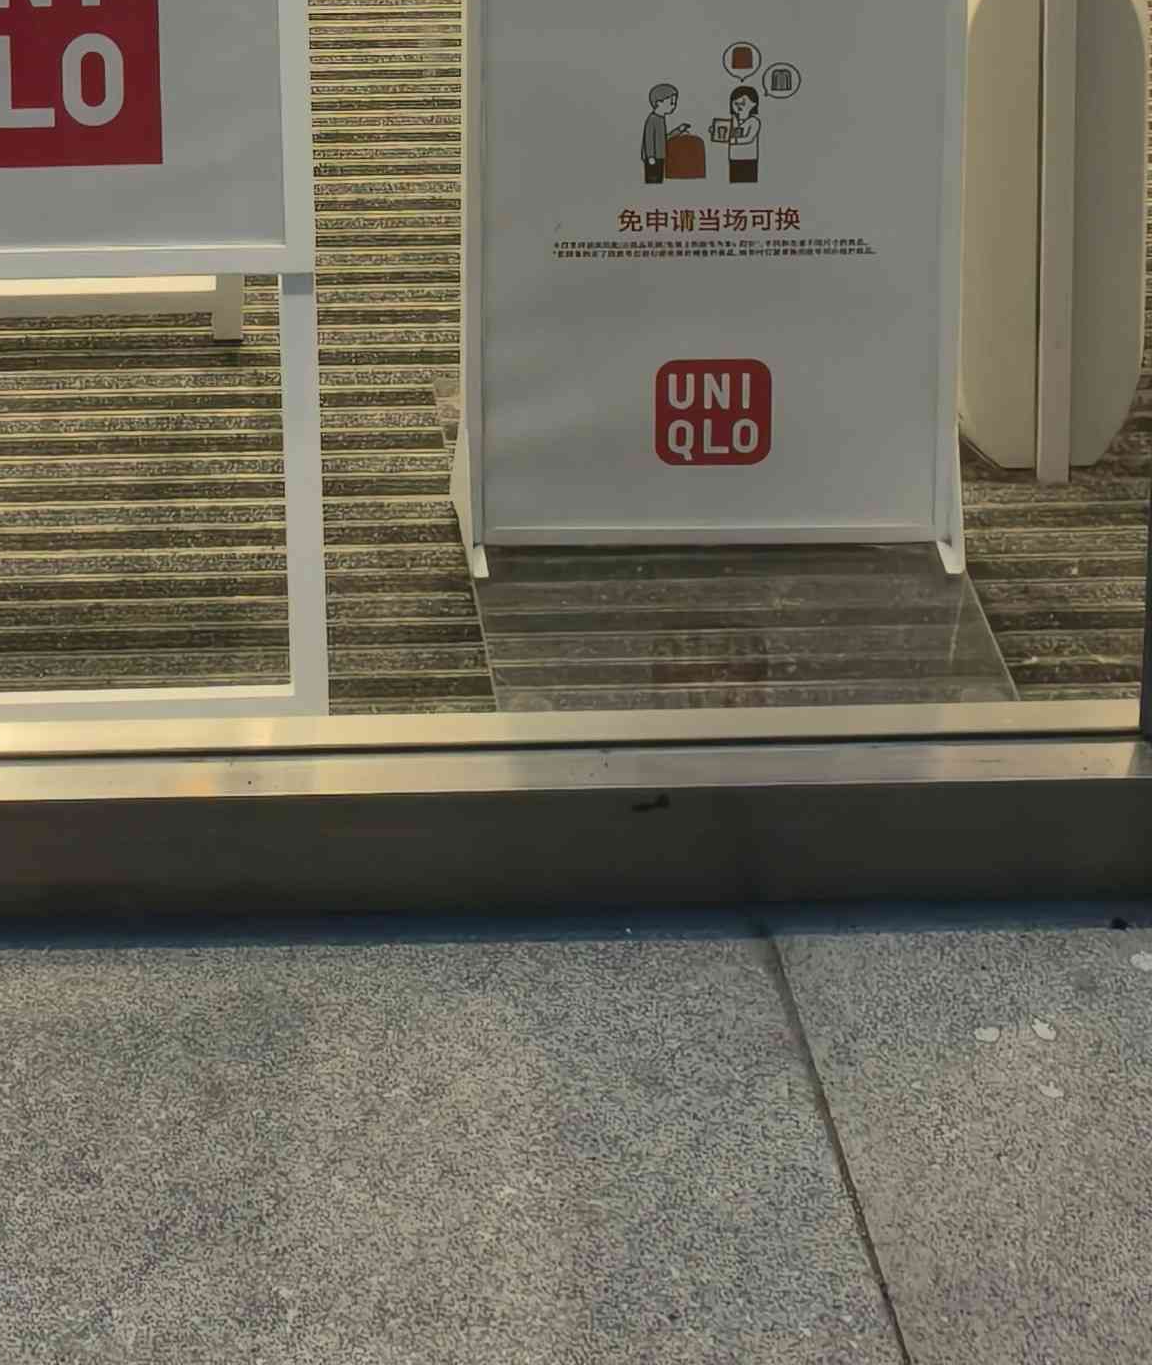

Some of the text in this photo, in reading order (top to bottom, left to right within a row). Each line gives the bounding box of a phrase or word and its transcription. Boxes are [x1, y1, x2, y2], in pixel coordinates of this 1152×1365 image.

[617, 207, 800, 232] 免申请当场可换
[668, 373, 750, 409] UNI
[668, 418, 759, 461] QLO
